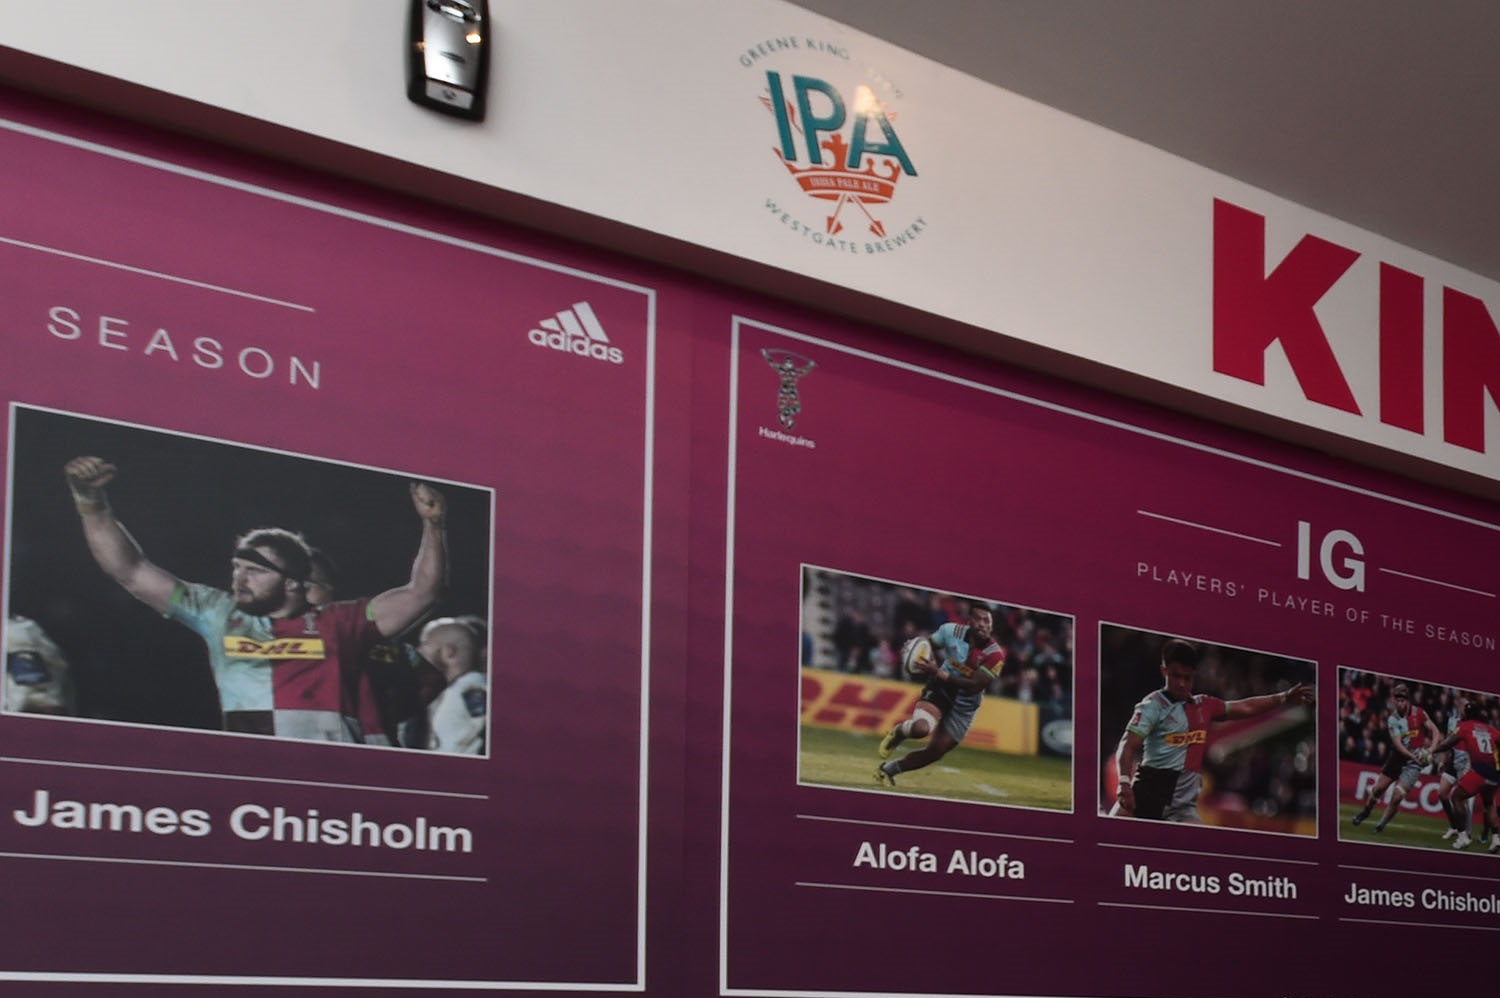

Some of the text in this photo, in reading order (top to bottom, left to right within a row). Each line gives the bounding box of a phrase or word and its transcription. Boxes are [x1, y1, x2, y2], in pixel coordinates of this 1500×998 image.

[740, 36, 800, 68] GREENE
[765, 69, 919, 178] IPA
[810, 176, 881, 193] INDIA PALE ALE
[764, 198, 927, 254] WESTGATE BREWERY
[47, 306, 322, 390] SEASON
[528, 328, 624, 365] adidas
[758, 426, 816, 449] Harlequins
[1297, 520, 1366, 593] IG
[1258, 588, 1336, 618] PLAYER
[1346, 607, 1371, 625] OF
[1381, 614, 1416, 635] THE
[1425, 623, 1497, 652] SEASON
[13, 789, 473, 853] James Chisholm
[853, 842, 1026, 880] Alofa Alofa
[1124, 864, 1298, 900] Marcus Smith
[1344, 882, 1416, 910] James
